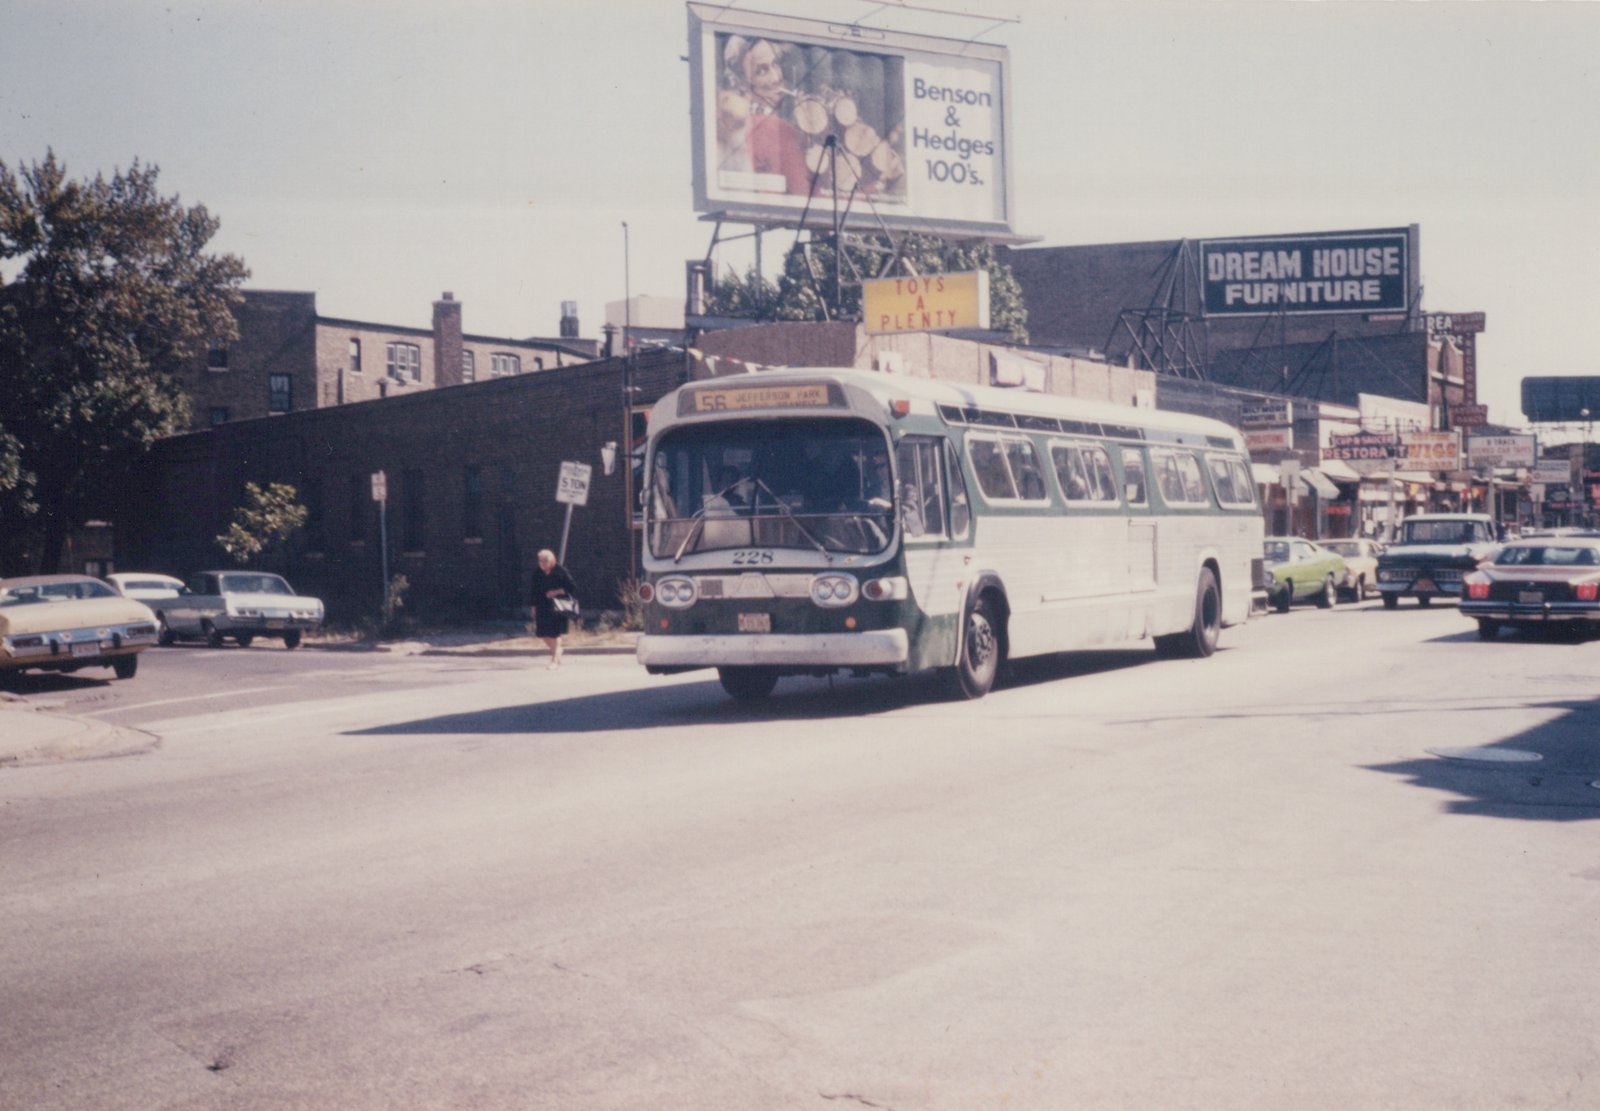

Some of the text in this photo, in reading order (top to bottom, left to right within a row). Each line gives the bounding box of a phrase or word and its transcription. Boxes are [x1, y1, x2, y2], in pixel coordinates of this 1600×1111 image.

[914, 78, 992, 107] Benson
[945, 105, 963, 127] &
[913, 127, 994, 160] Hedges
[926, 160, 984, 185] 100's.
[1208, 247, 1400, 281] DREAM HOUSE
[896, 276, 945, 296] TOYS
[1225, 280, 1381, 305] FURNITURE
[916, 296, 925, 311] A
[881, 310, 957, 331] PLENTY
[702, 390, 820, 410] 56 JEFFERSON PARK
[1408, 443, 1457, 458] WIGS
[1494, 438, 1516, 446] TRACK
[1323, 446, 1407, 460] RESTORAT
[570, 478, 587, 491] TON
[733, 551, 774, 565] 228
